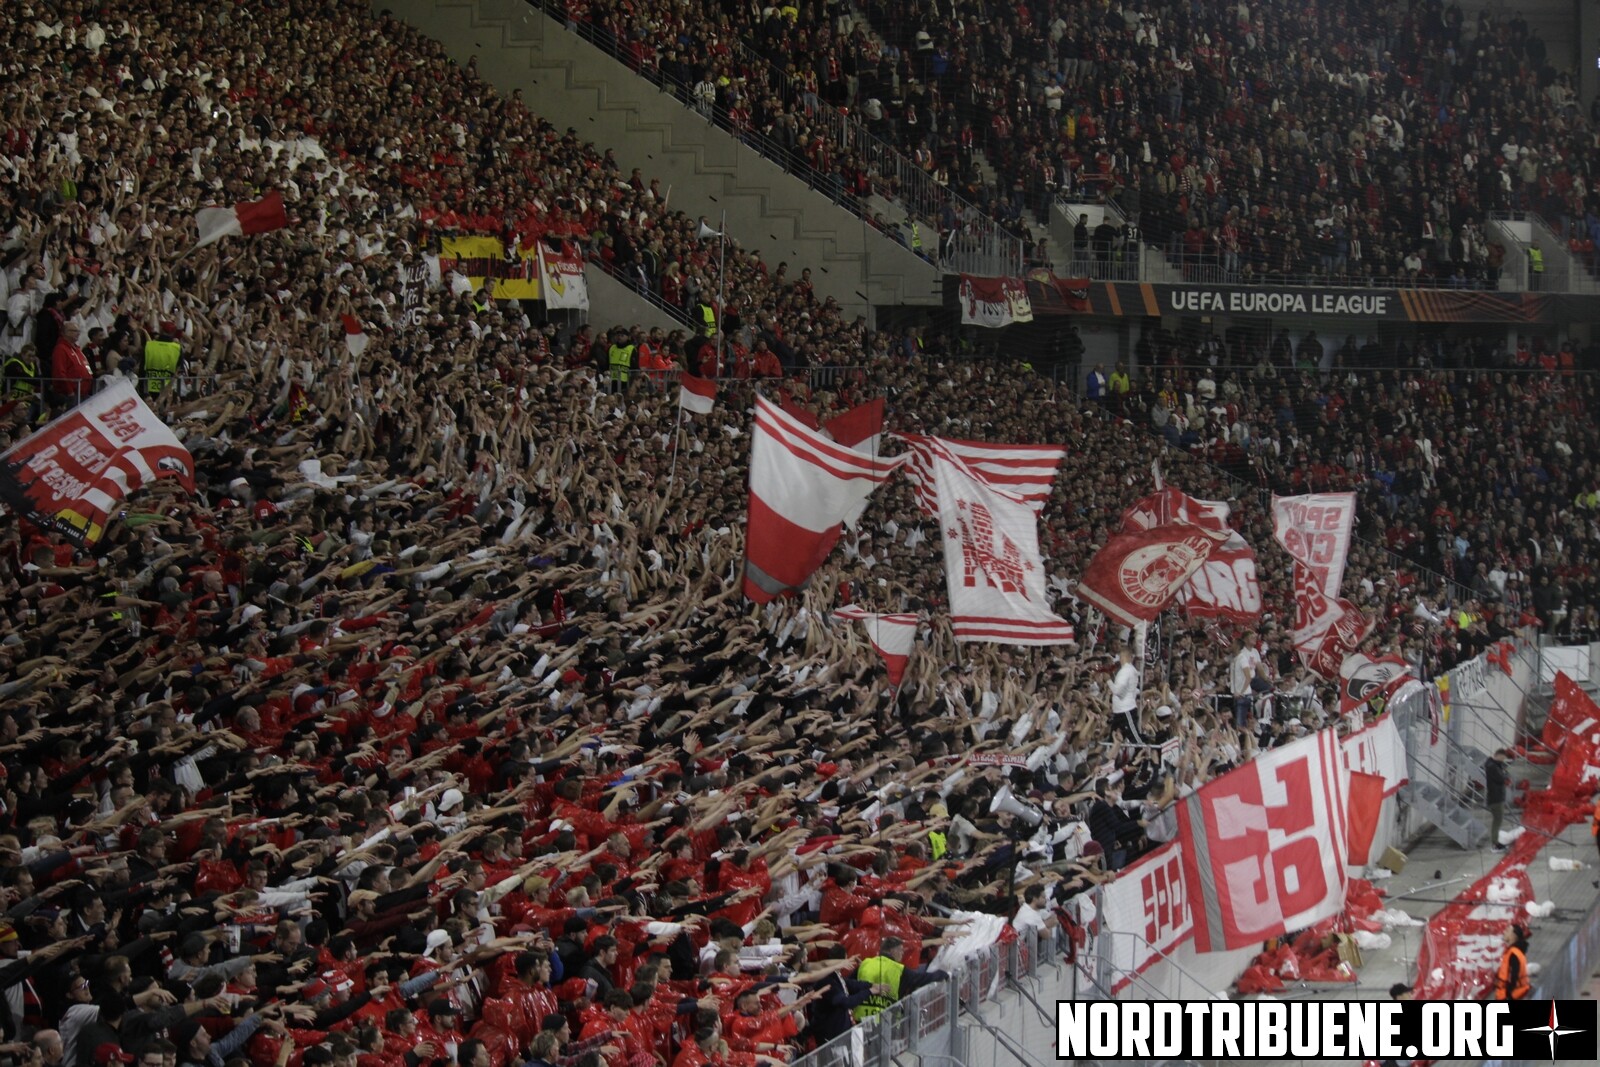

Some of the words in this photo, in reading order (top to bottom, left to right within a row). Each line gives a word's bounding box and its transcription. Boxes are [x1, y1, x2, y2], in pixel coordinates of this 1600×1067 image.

[1171, 291, 1225, 311] UEFA
[1230, 292, 1307, 312] EUROPA
[1311, 294, 1386, 314] LEAGUE
